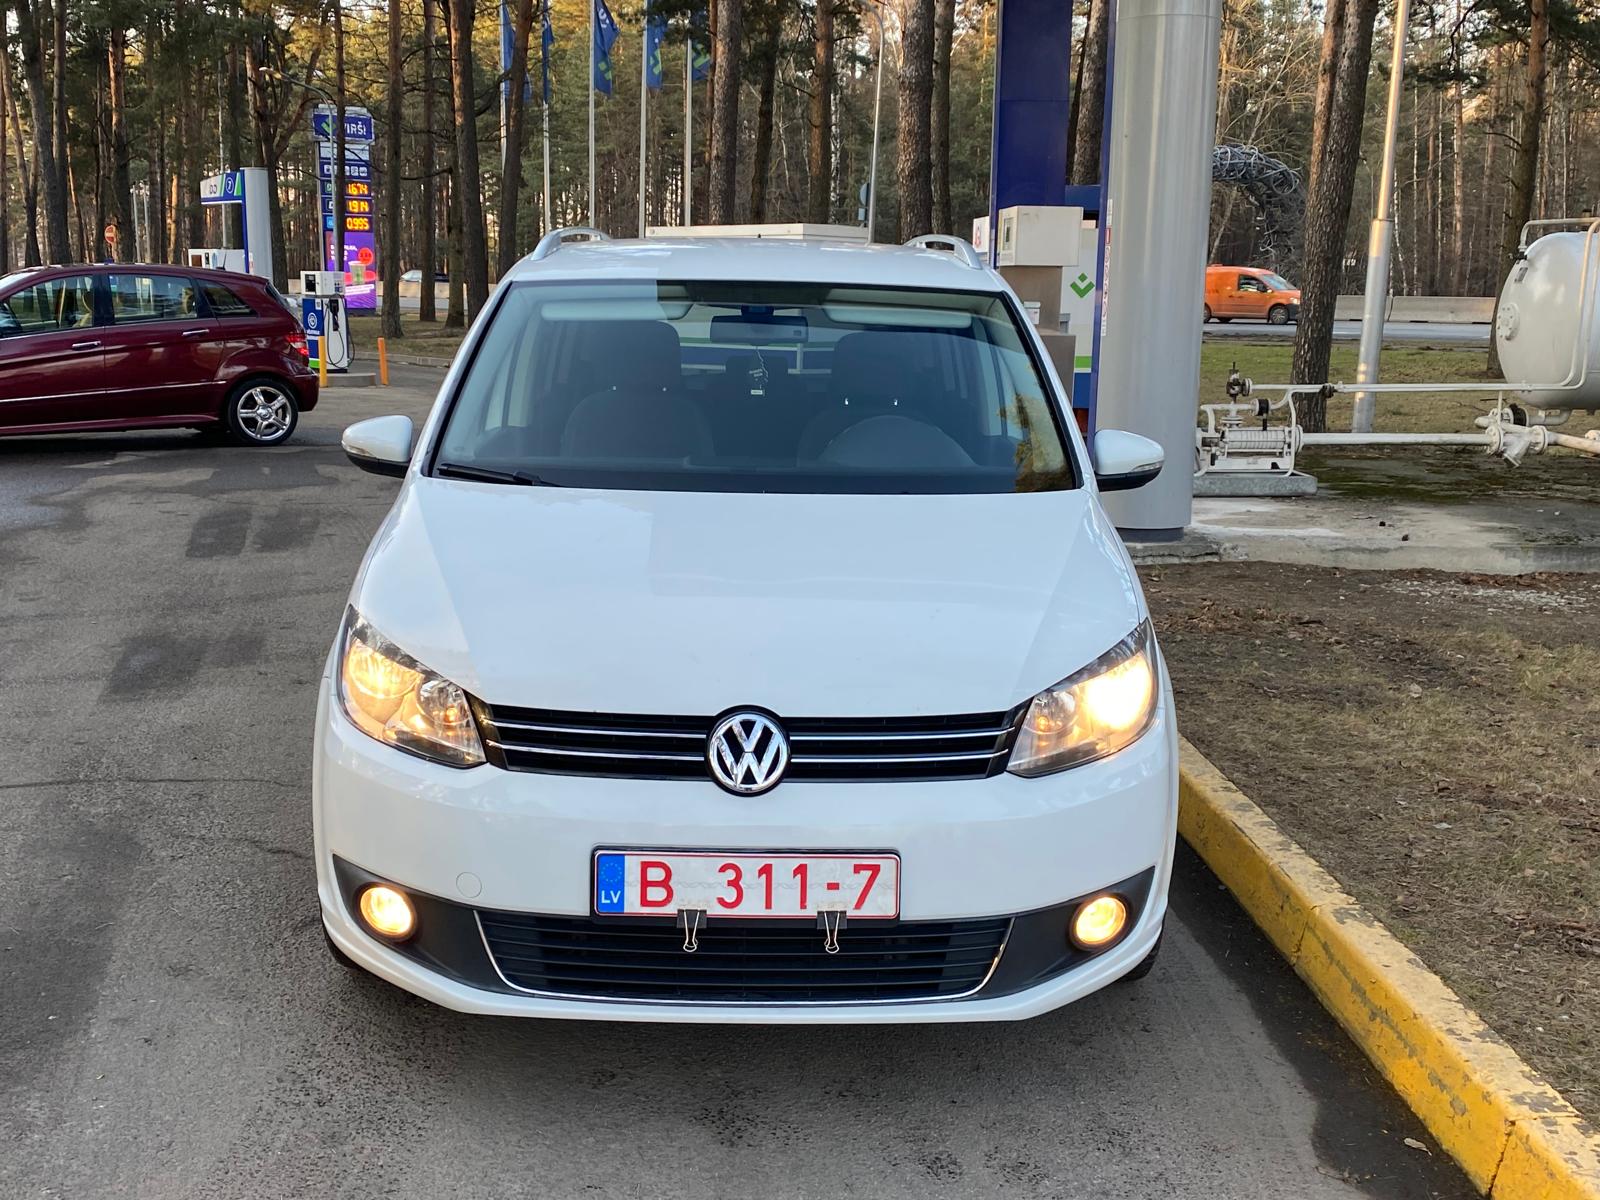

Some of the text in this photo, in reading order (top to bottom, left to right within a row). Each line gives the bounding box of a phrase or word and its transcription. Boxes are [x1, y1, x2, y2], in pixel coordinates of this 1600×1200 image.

[345, 121, 367, 136] IRŠI
[639, 860, 882, 910] B 311-7
[600, 890, 622, 905] LV
